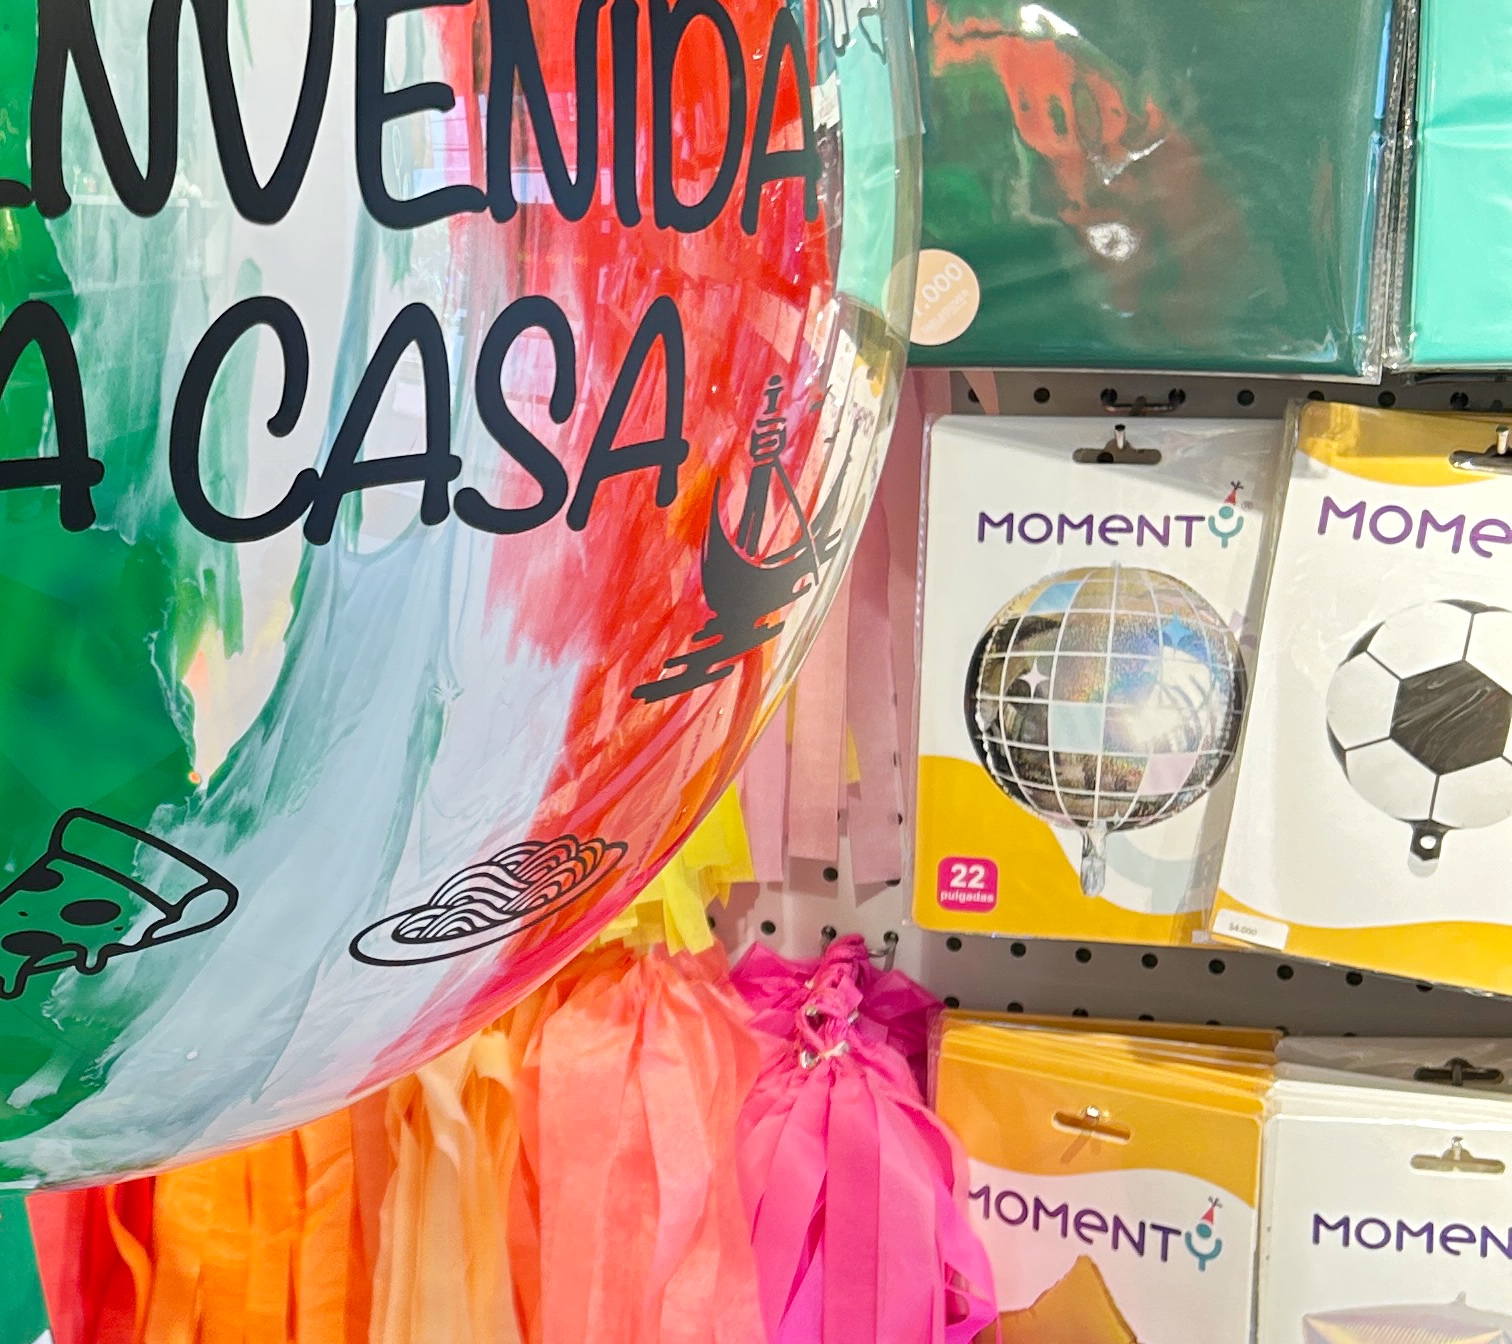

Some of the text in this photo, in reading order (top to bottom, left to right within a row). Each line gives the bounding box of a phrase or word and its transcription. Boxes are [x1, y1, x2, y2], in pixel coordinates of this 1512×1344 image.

[169, 294, 691, 547] CASA
[949, 862, 986, 889] 22
[939, 890, 995, 904] pulgadas
